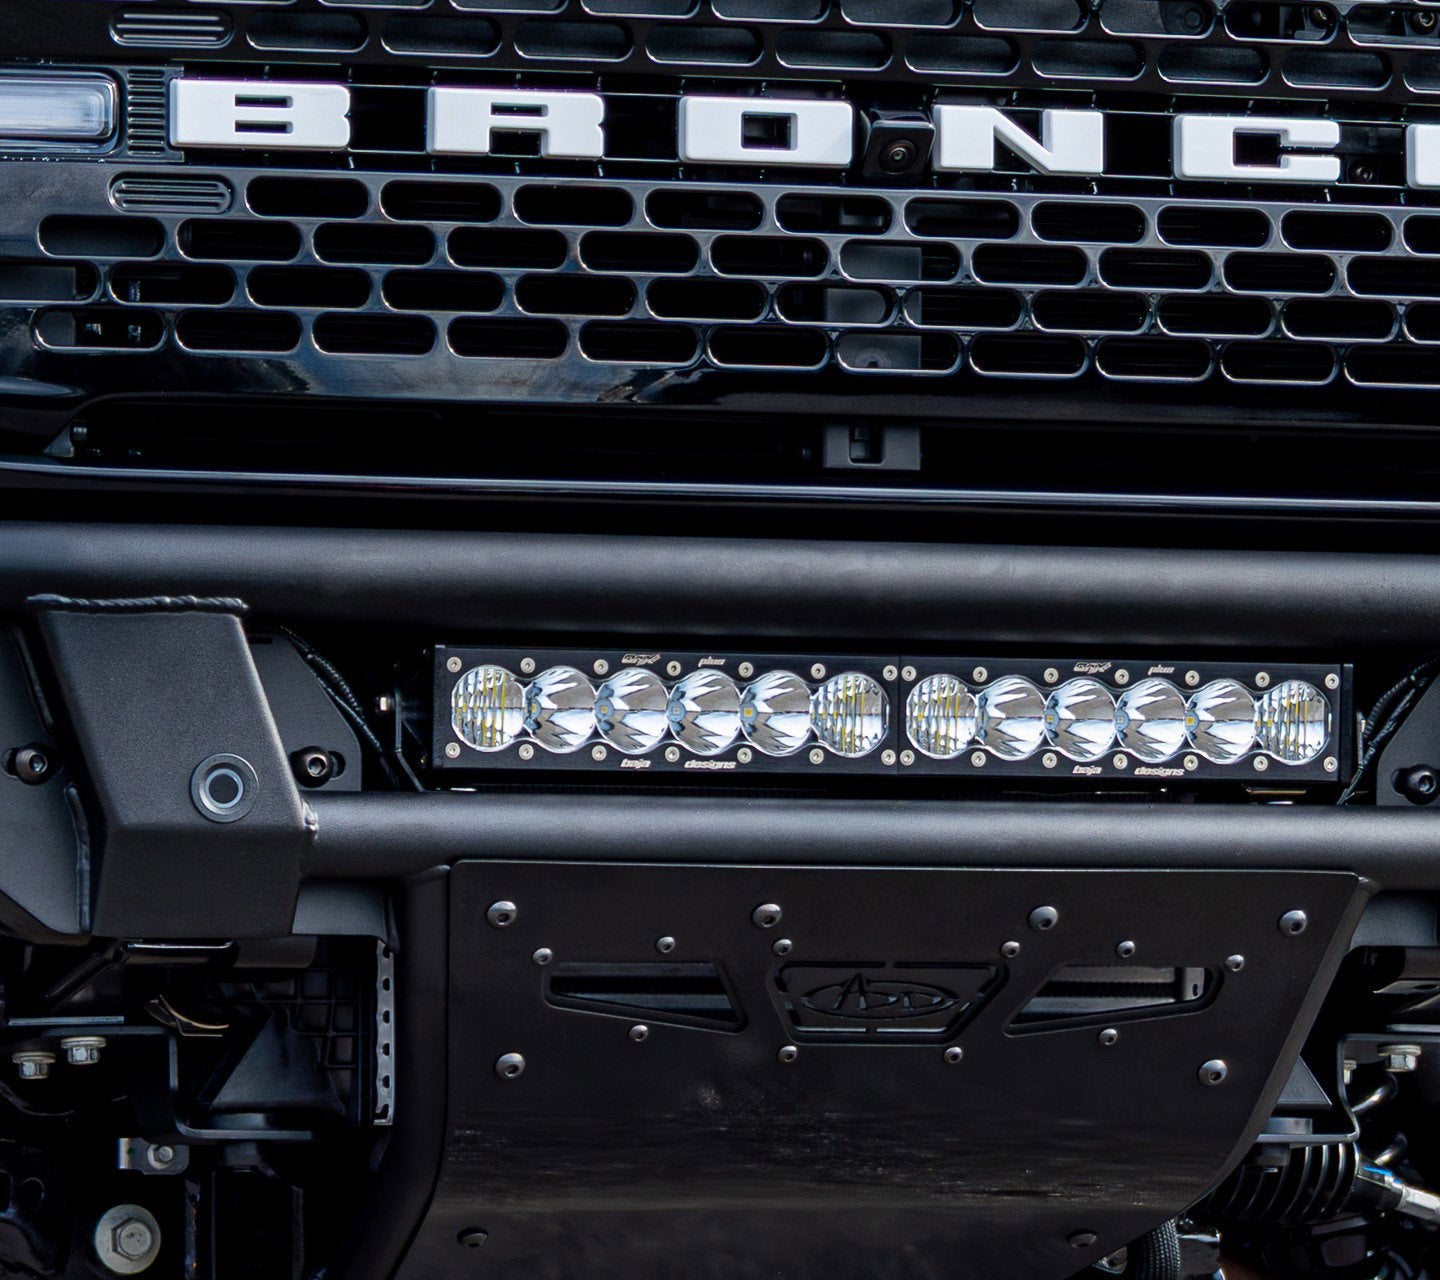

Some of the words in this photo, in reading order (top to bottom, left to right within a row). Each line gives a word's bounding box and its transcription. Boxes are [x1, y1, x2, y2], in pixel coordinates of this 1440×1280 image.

[620, 758, 652, 769] baja
[684, 760, 738, 771] designs
[1072, 765, 1103, 776] baja
[1134, 766, 1186, 777] designs
